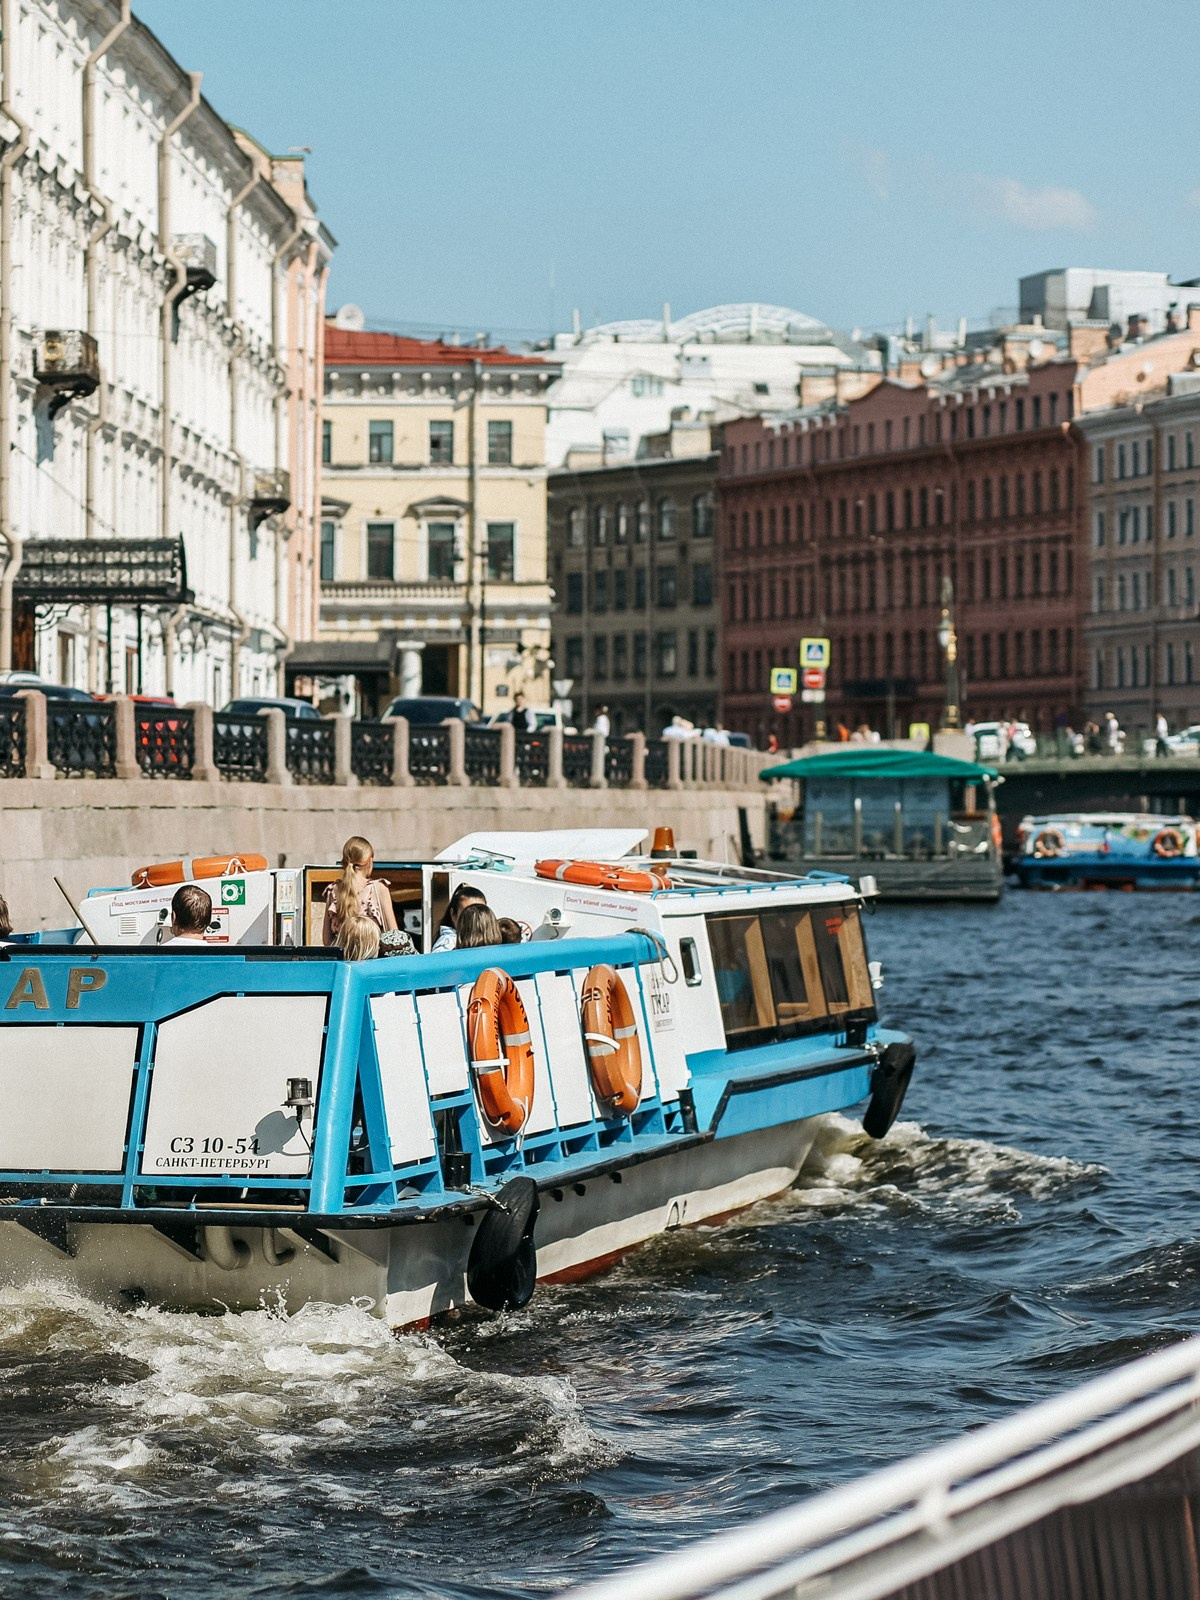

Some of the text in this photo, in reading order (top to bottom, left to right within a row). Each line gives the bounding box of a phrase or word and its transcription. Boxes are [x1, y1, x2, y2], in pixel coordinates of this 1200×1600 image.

[111, 900, 124, 908] Под
[125, 898, 150, 906] мостами
[566, 896, 582, 904] Don't
[583, 899, 600, 907] stand
[619, 904, 638, 913] bridge
[155, 1157, 271, 1169] САНКТ-ПЕТЕРБУРГ
